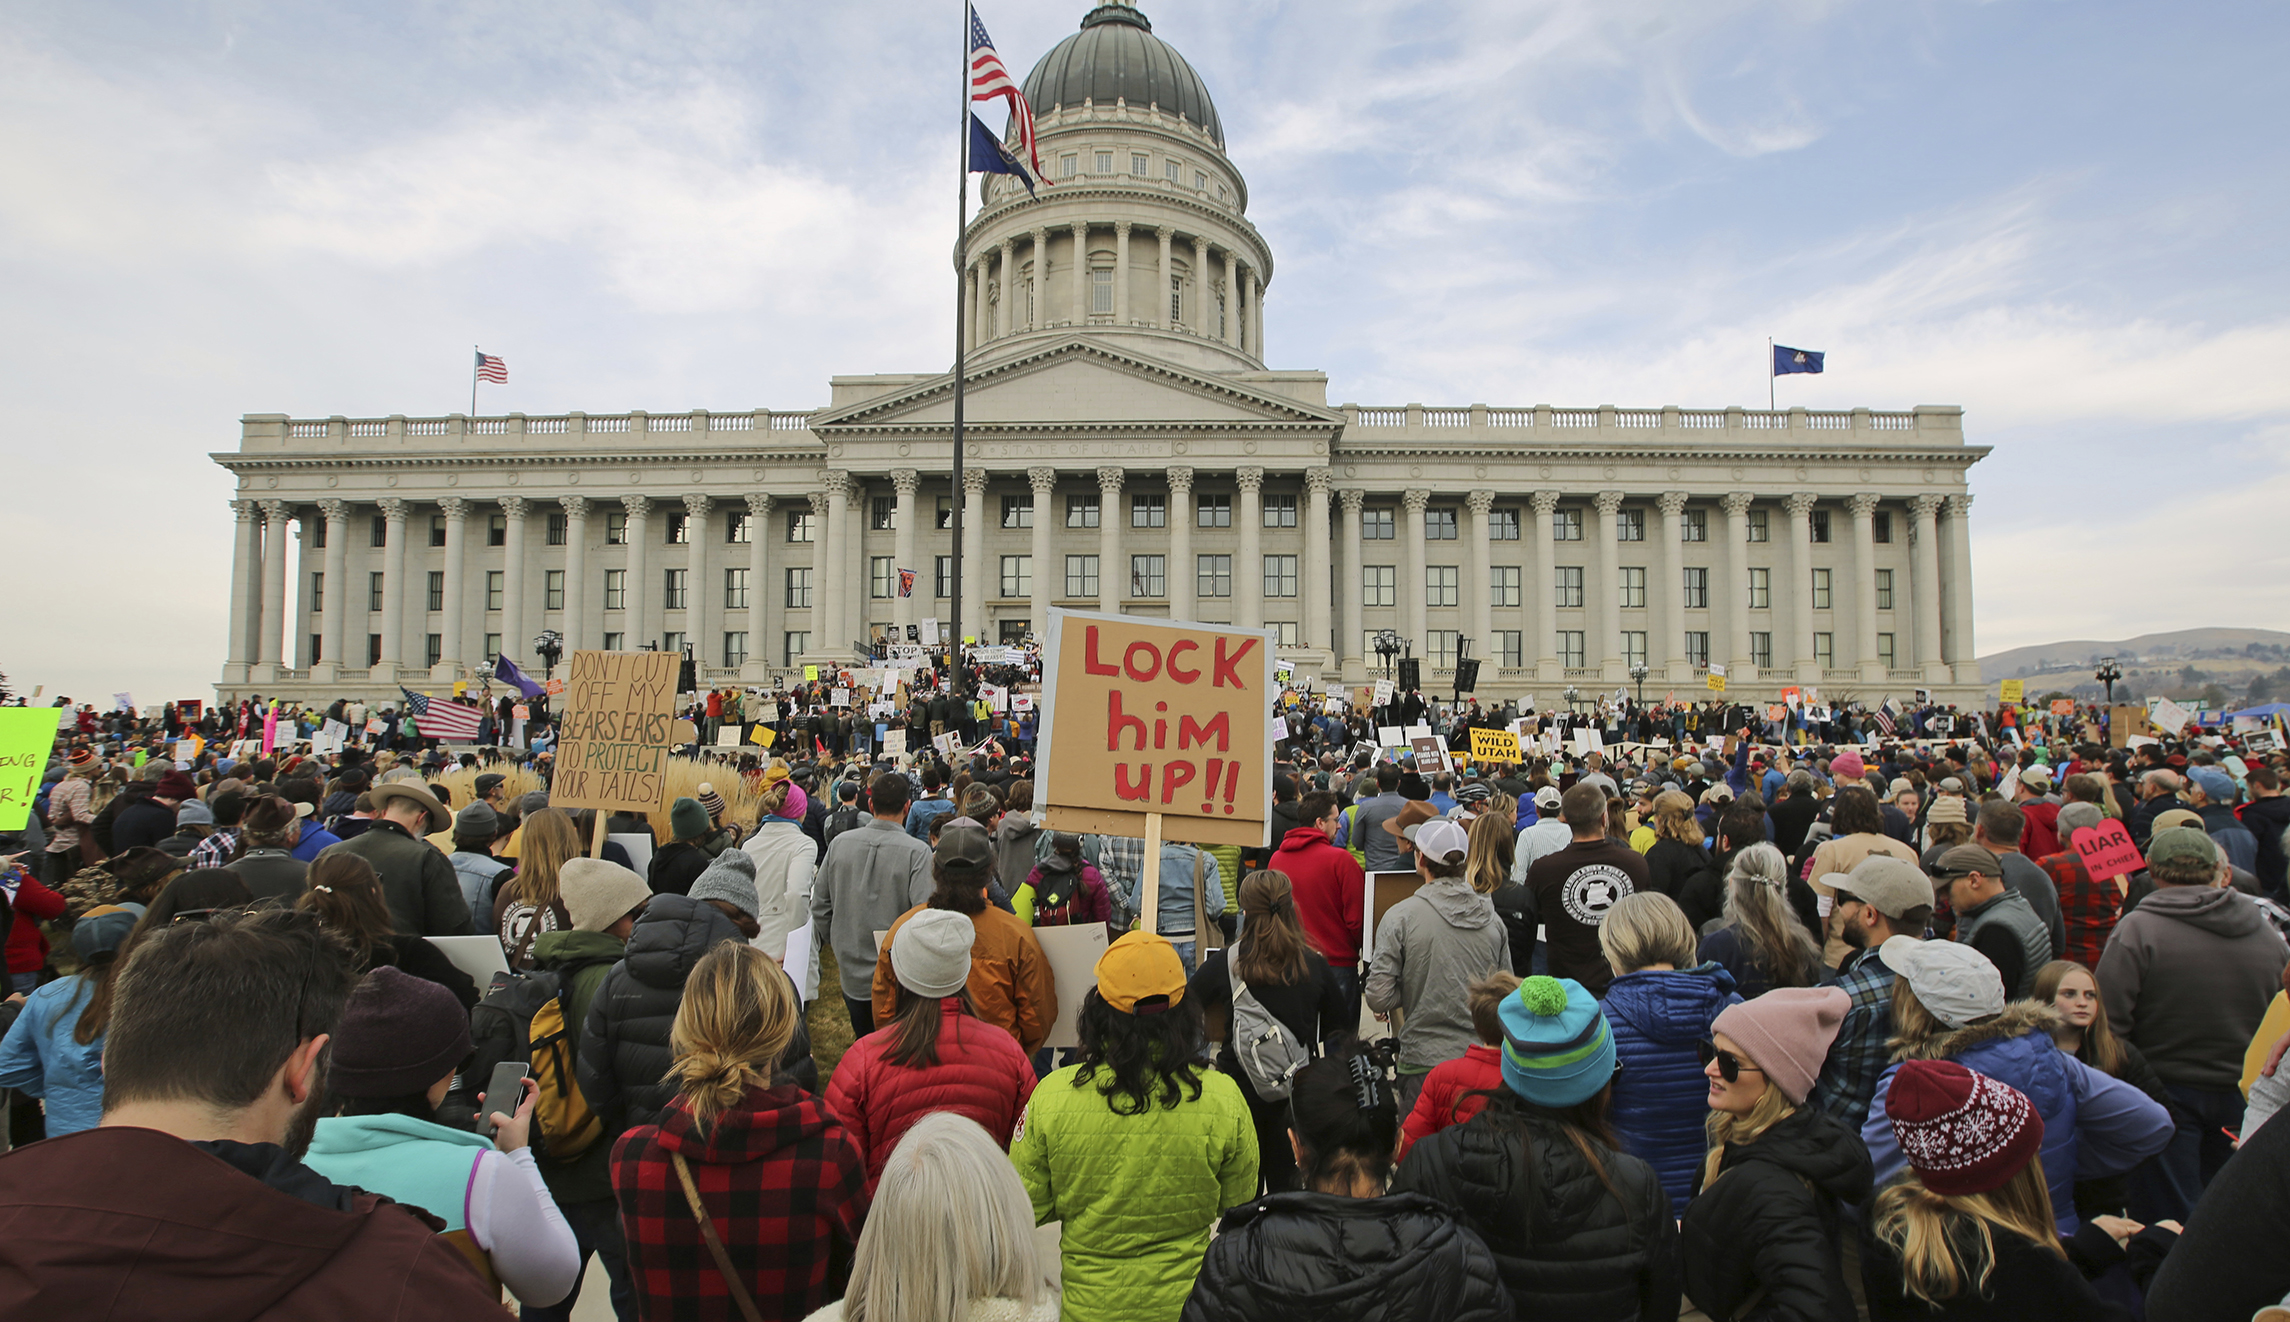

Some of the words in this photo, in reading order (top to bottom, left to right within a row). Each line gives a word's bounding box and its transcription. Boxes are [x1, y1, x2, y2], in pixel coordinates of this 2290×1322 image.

[1002, 444, 1058, 455] STATE
[1069, 444, 1088, 455] OF
[1101, 444, 1150, 455] UTAH
[571, 652, 625, 681] DON'T
[631, 653, 678, 683] CUT
[1085, 625, 1259, 690] LOCK
[576, 680, 616, 711] OFF
[626, 682, 666, 712] MY
[560, 710, 618, 741] BEARS
[620, 711, 669, 744] EARS
[1477, 736, 1513, 747] WILD
[560, 741, 580, 769] TO
[584, 742, 668, 773] PROTECT
[1477, 747, 1516, 758] UTAH
[556, 769, 589, 799] YOUR
[599, 771, 663, 805] TAILS!
[2078, 831, 2128, 857] LIAR
[2090, 862, 2103, 873] IN
[2106, 852, 2137, 868] CHIEF
